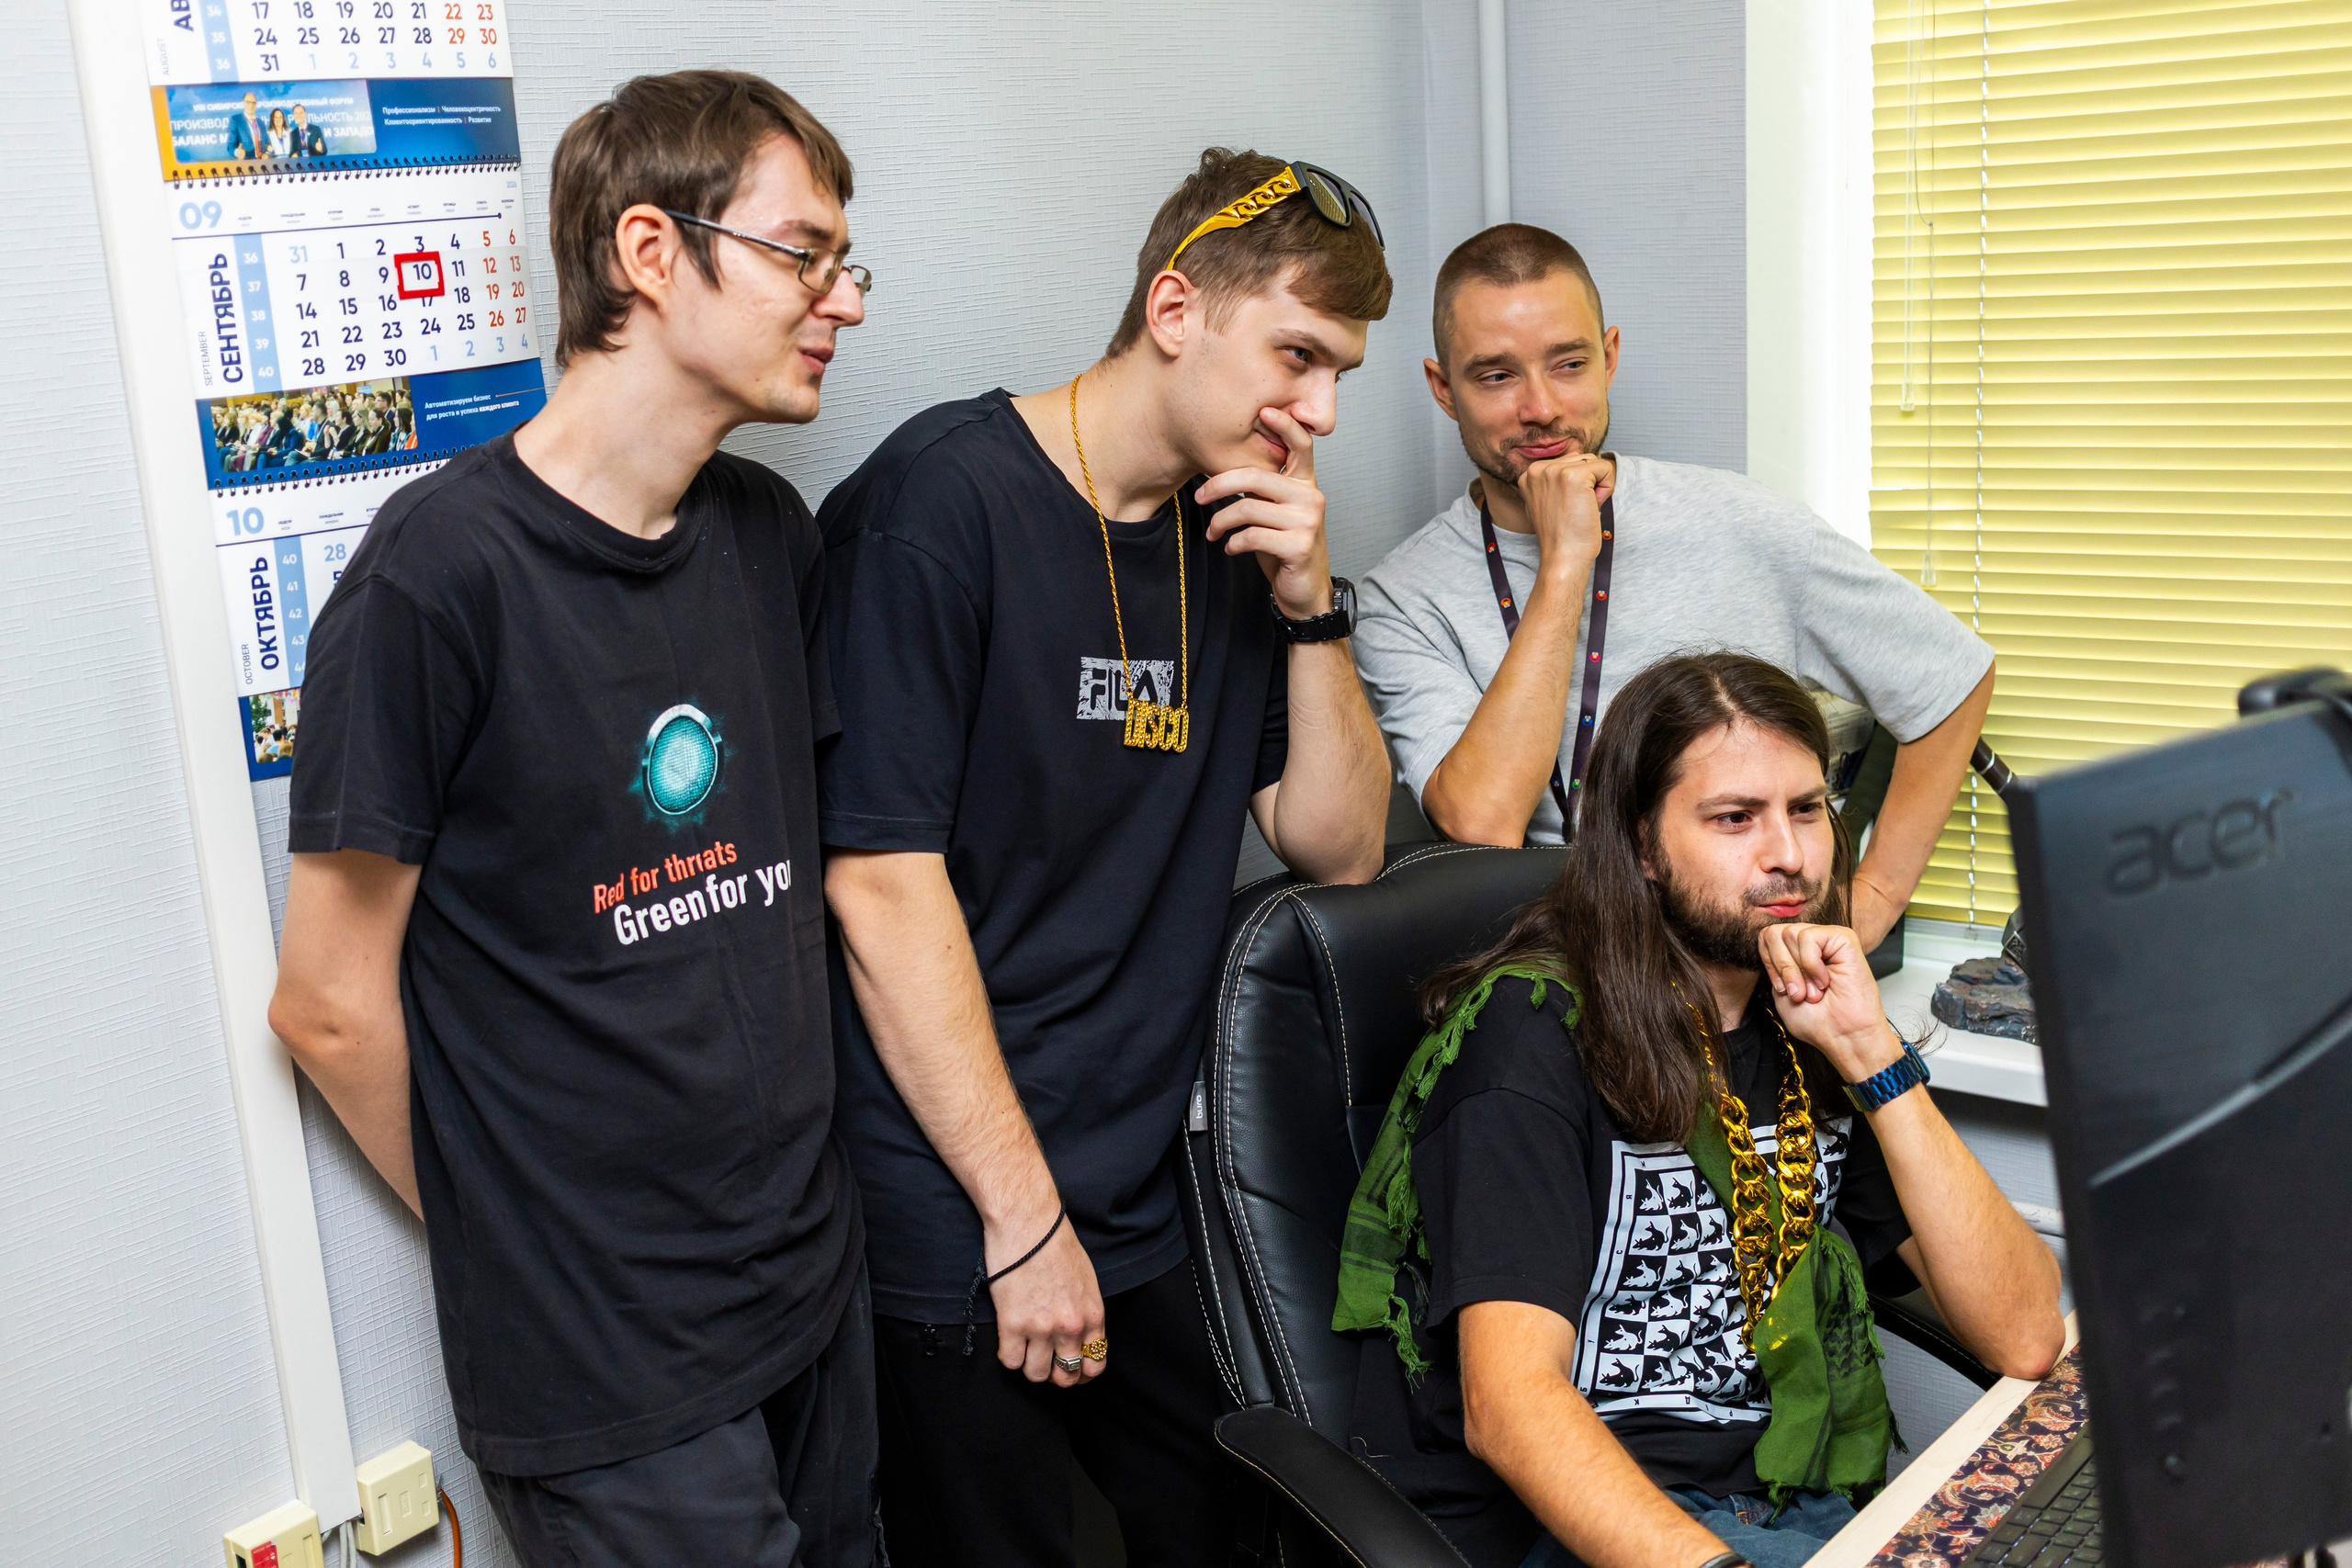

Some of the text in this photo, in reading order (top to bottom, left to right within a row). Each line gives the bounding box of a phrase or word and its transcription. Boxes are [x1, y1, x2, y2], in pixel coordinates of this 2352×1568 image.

[207, 2, 493, 20] 34 17 18 19 20 21 22 23
[211, 27, 496, 45] 35 24 25 26 27 28 29 30
[157, 39, 169, 76] AUGUST
[216, 52, 496, 72] 36 31 1 2 3 4 5 6
[207, 101, 244, 110] СИБИРСК
[256, 97, 328, 107] РОИЗВОДСТВЕННЫЙ
[179, 201, 221, 230] 09
[243, 230, 515, 264] 36 31 1 2 3 4 5 6
[247, 256, 521, 292] 37 7 8 9 10 11 12 13
[208, 253, 243, 383] СЕНТЯБРЬ
[251, 310, 266, 321] 38
[296, 302, 317, 320] 14
[339, 298, 357, 315] 15
[379, 294, 397, 311] 16
[455, 287, 469, 303] 18
[486, 284, 499, 299] 19
[512, 281, 524, 298] 20
[254, 307, 526, 349] 39 21 22 23 24 25 26 27
[198, 331, 213, 386] SEPTEMBER
[258, 333, 528, 377] 40 28 29 30 1 2 3 4
[424, 393, 492, 410] Автоматизируем бизнес
[426, 413, 438, 422] для
[438, 410, 456, 420] роста
[460, 406, 478, 416] успеха
[479, 403, 501, 412] каждого
[501, 400, 520, 409] клиента
[227, 507, 264, 536] 10
[283, 544, 346, 564] 40 28
[287, 581, 298, 591] 41
[250, 557, 279, 671] ОКТЯБРЬ
[289, 609, 301, 618] 42
[292, 636, 304, 645] 43
[241, 643, 254, 685] OCTOBER
[1123, 697, 1190, 753] DISCO
[2109, 786, 2294, 898] acer
[593, 874, 625, 914] Red
[630, 867, 659, 896] for
[614, 886, 707, 945] Green
[706, 874, 748, 913] for
